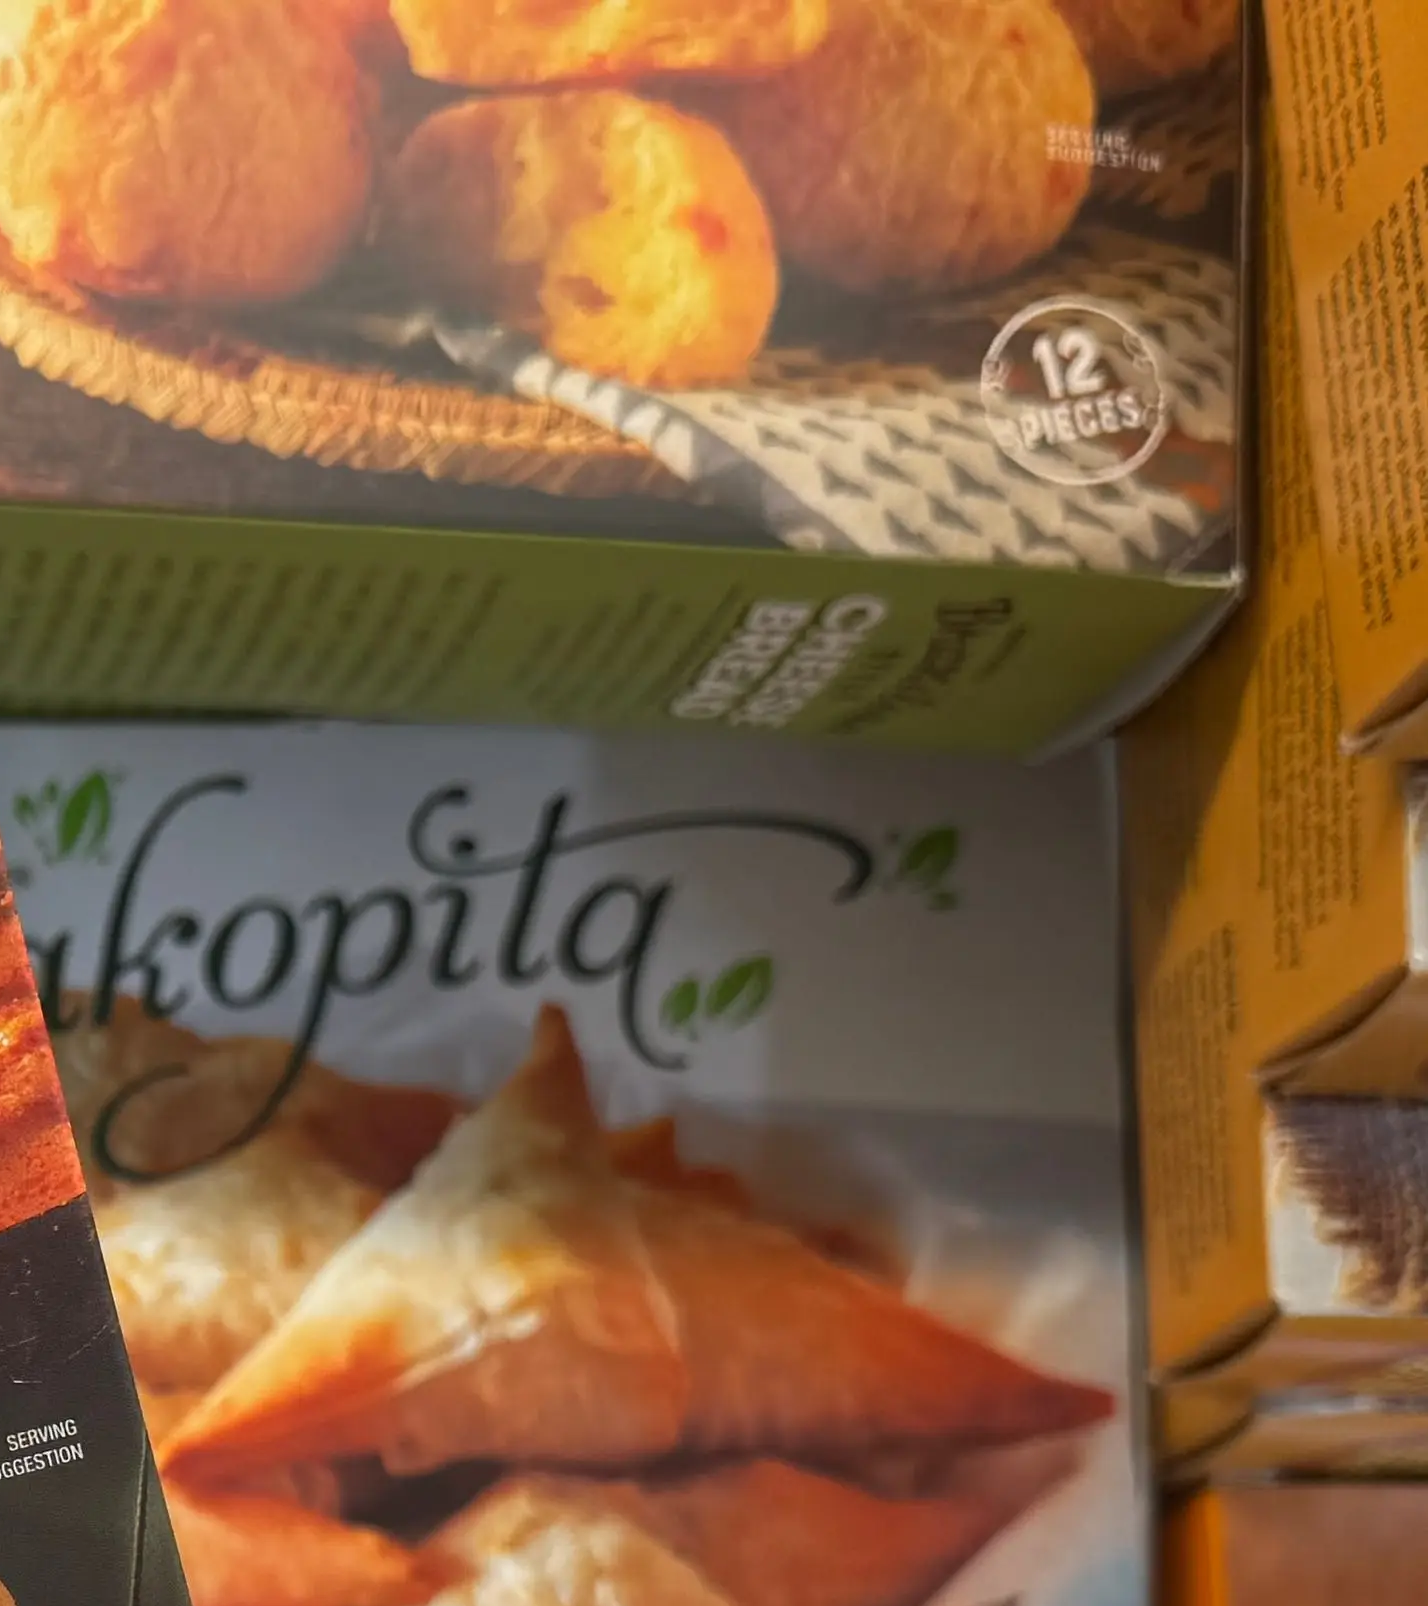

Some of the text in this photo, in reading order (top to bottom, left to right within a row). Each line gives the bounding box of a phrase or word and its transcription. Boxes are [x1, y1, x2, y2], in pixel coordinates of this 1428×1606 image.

[1031, 326, 1108, 400] 12
[1019, 389, 1146, 453] PIECES
[26, 771, 874, 1184] akopita
[6, 1419, 78, 1451] SERVING
